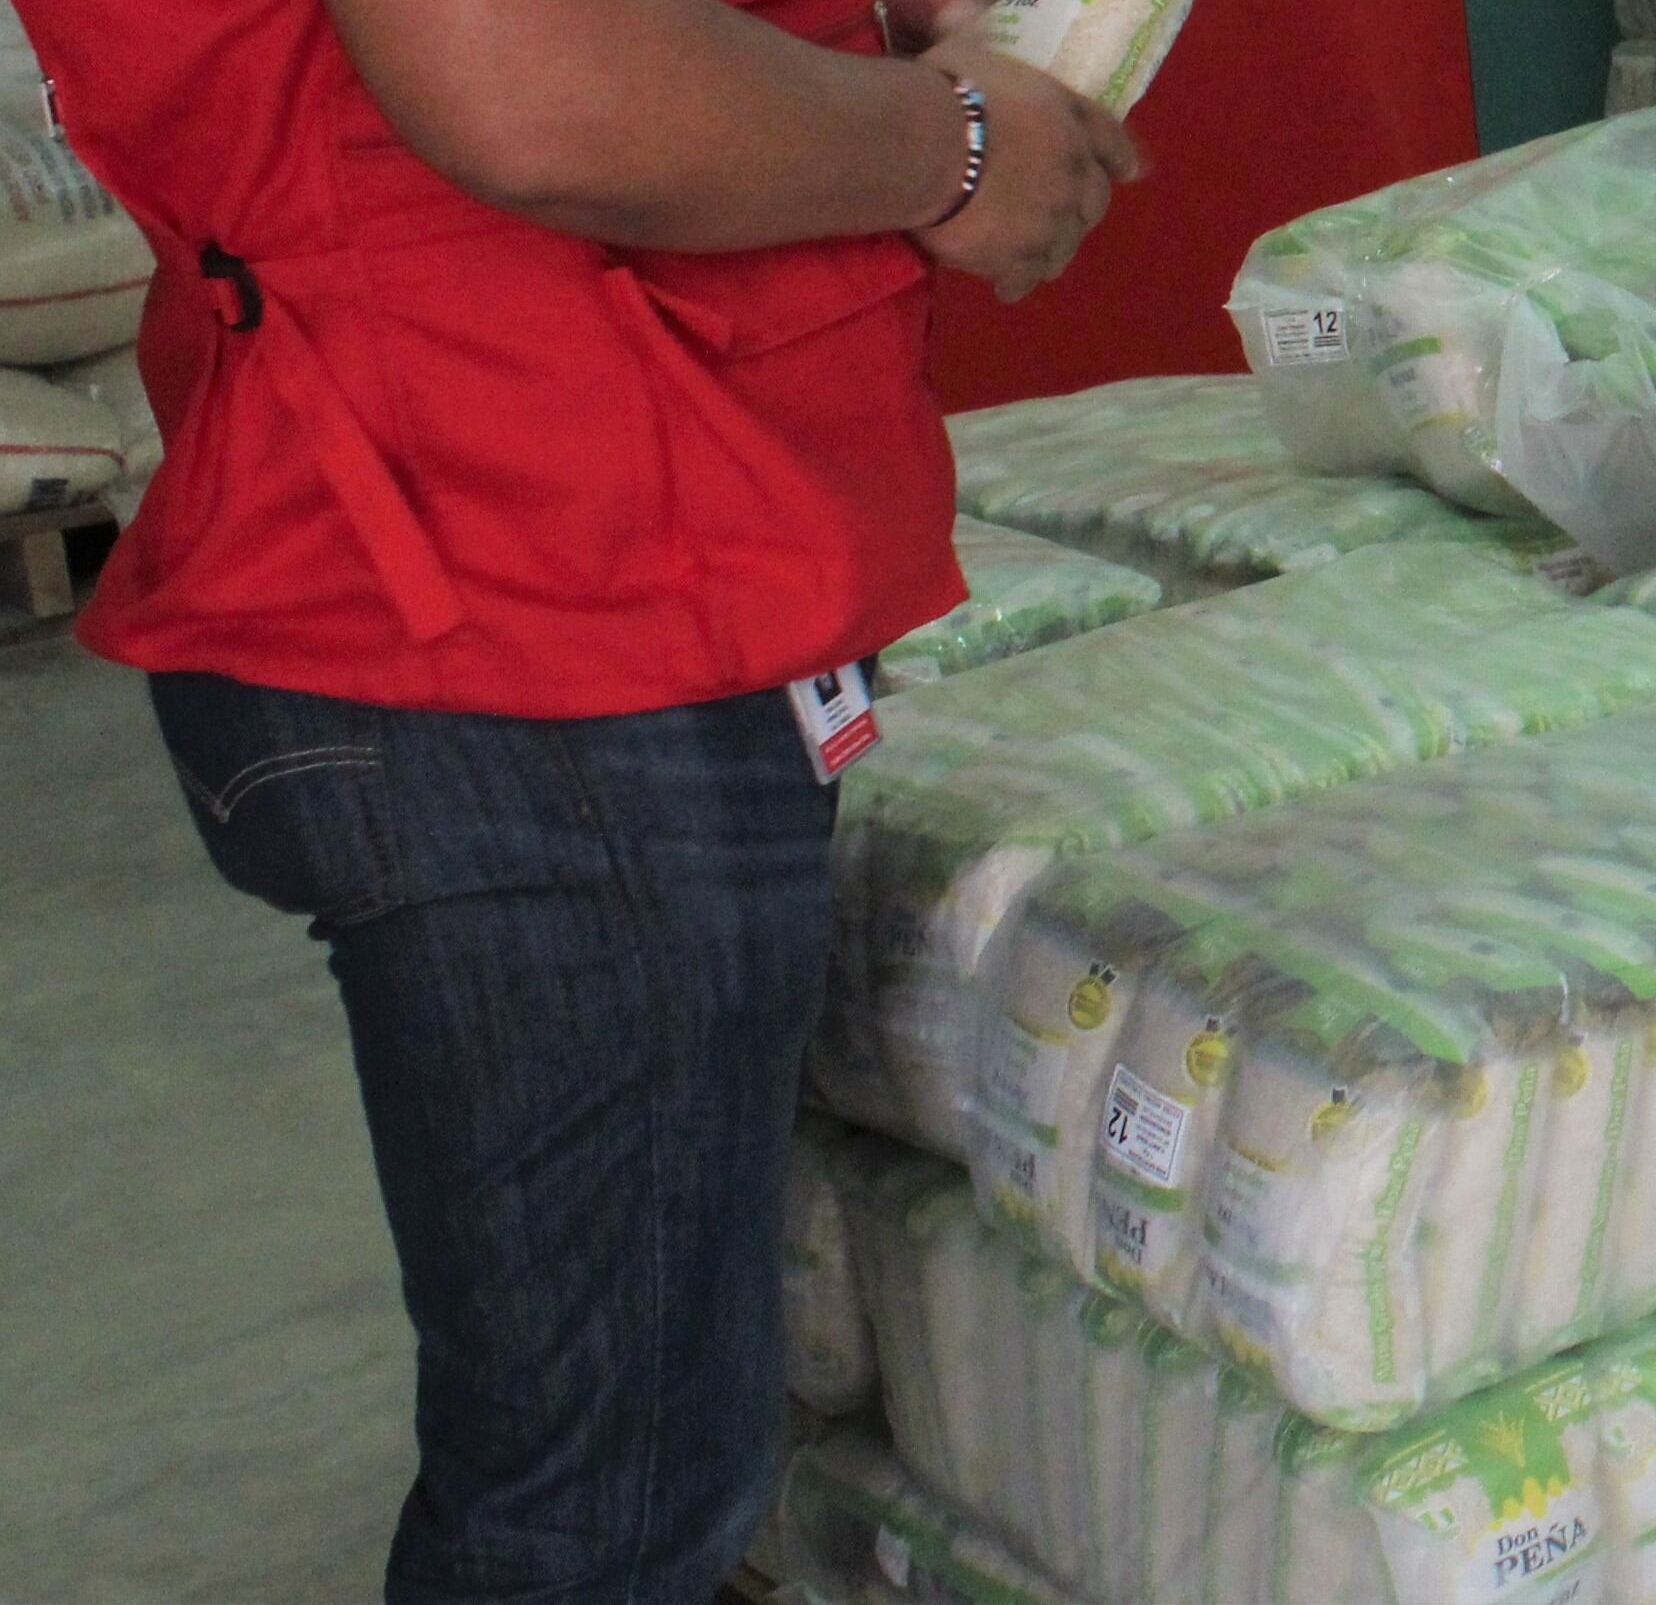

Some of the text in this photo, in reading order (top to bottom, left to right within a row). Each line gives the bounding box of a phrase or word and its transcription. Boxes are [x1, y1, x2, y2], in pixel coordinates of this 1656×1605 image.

[1313, 311, 1338, 334] 12
[1107, 1106, 1129, 1145] 12
[1494, 1515, 1588, 1589] PEÑA
[1496, 1526, 1539, 1556] Don
